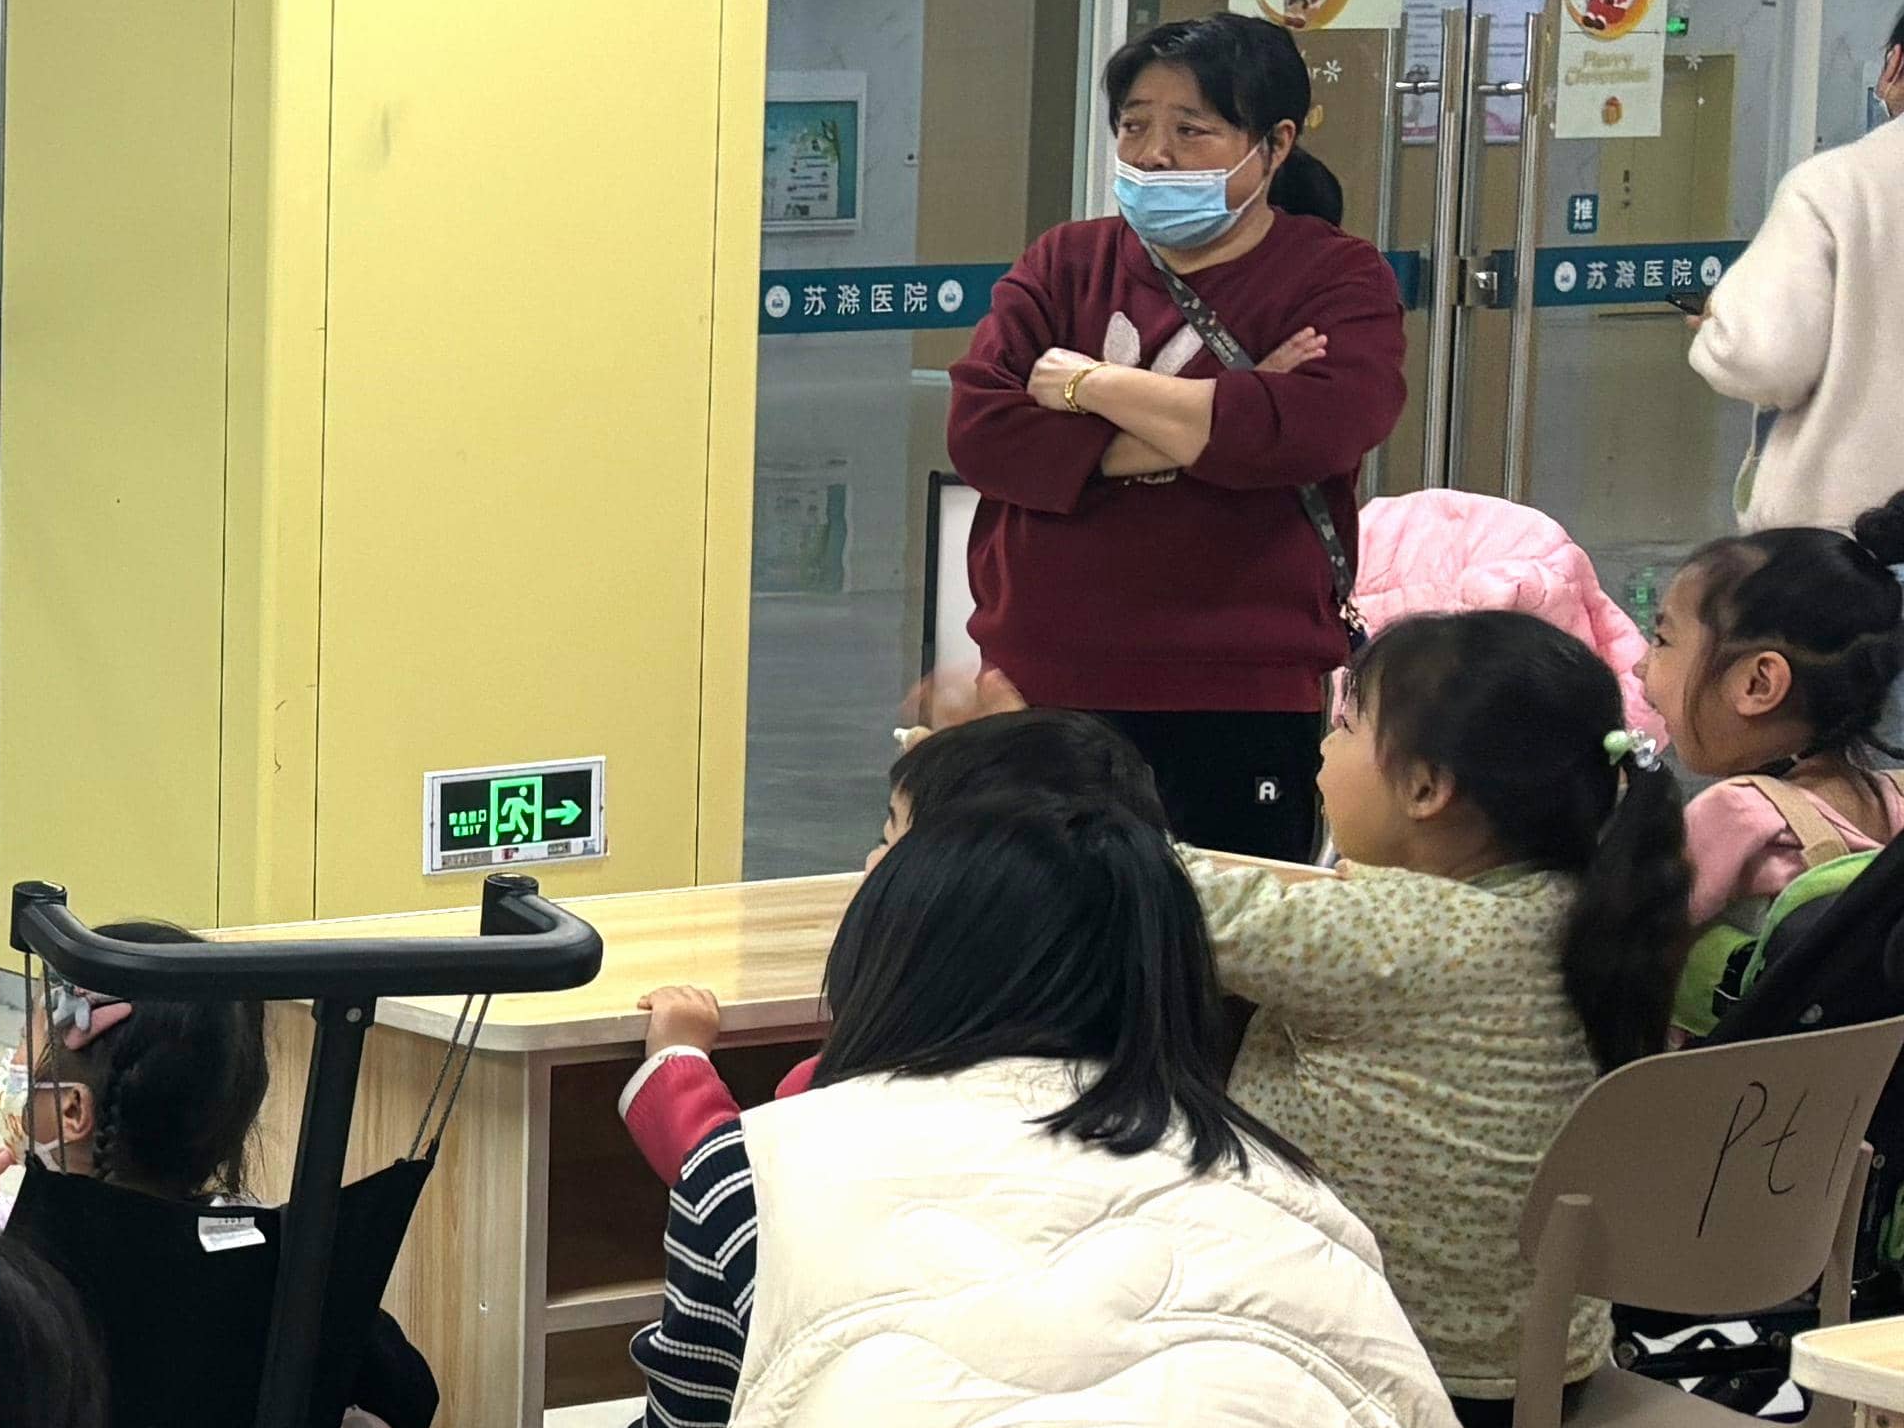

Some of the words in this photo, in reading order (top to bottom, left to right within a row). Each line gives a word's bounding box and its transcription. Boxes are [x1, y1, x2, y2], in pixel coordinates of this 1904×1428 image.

[1586, 258, 1692, 290] 苏滁医院
[803, 281, 928, 316] 苏滁医院
